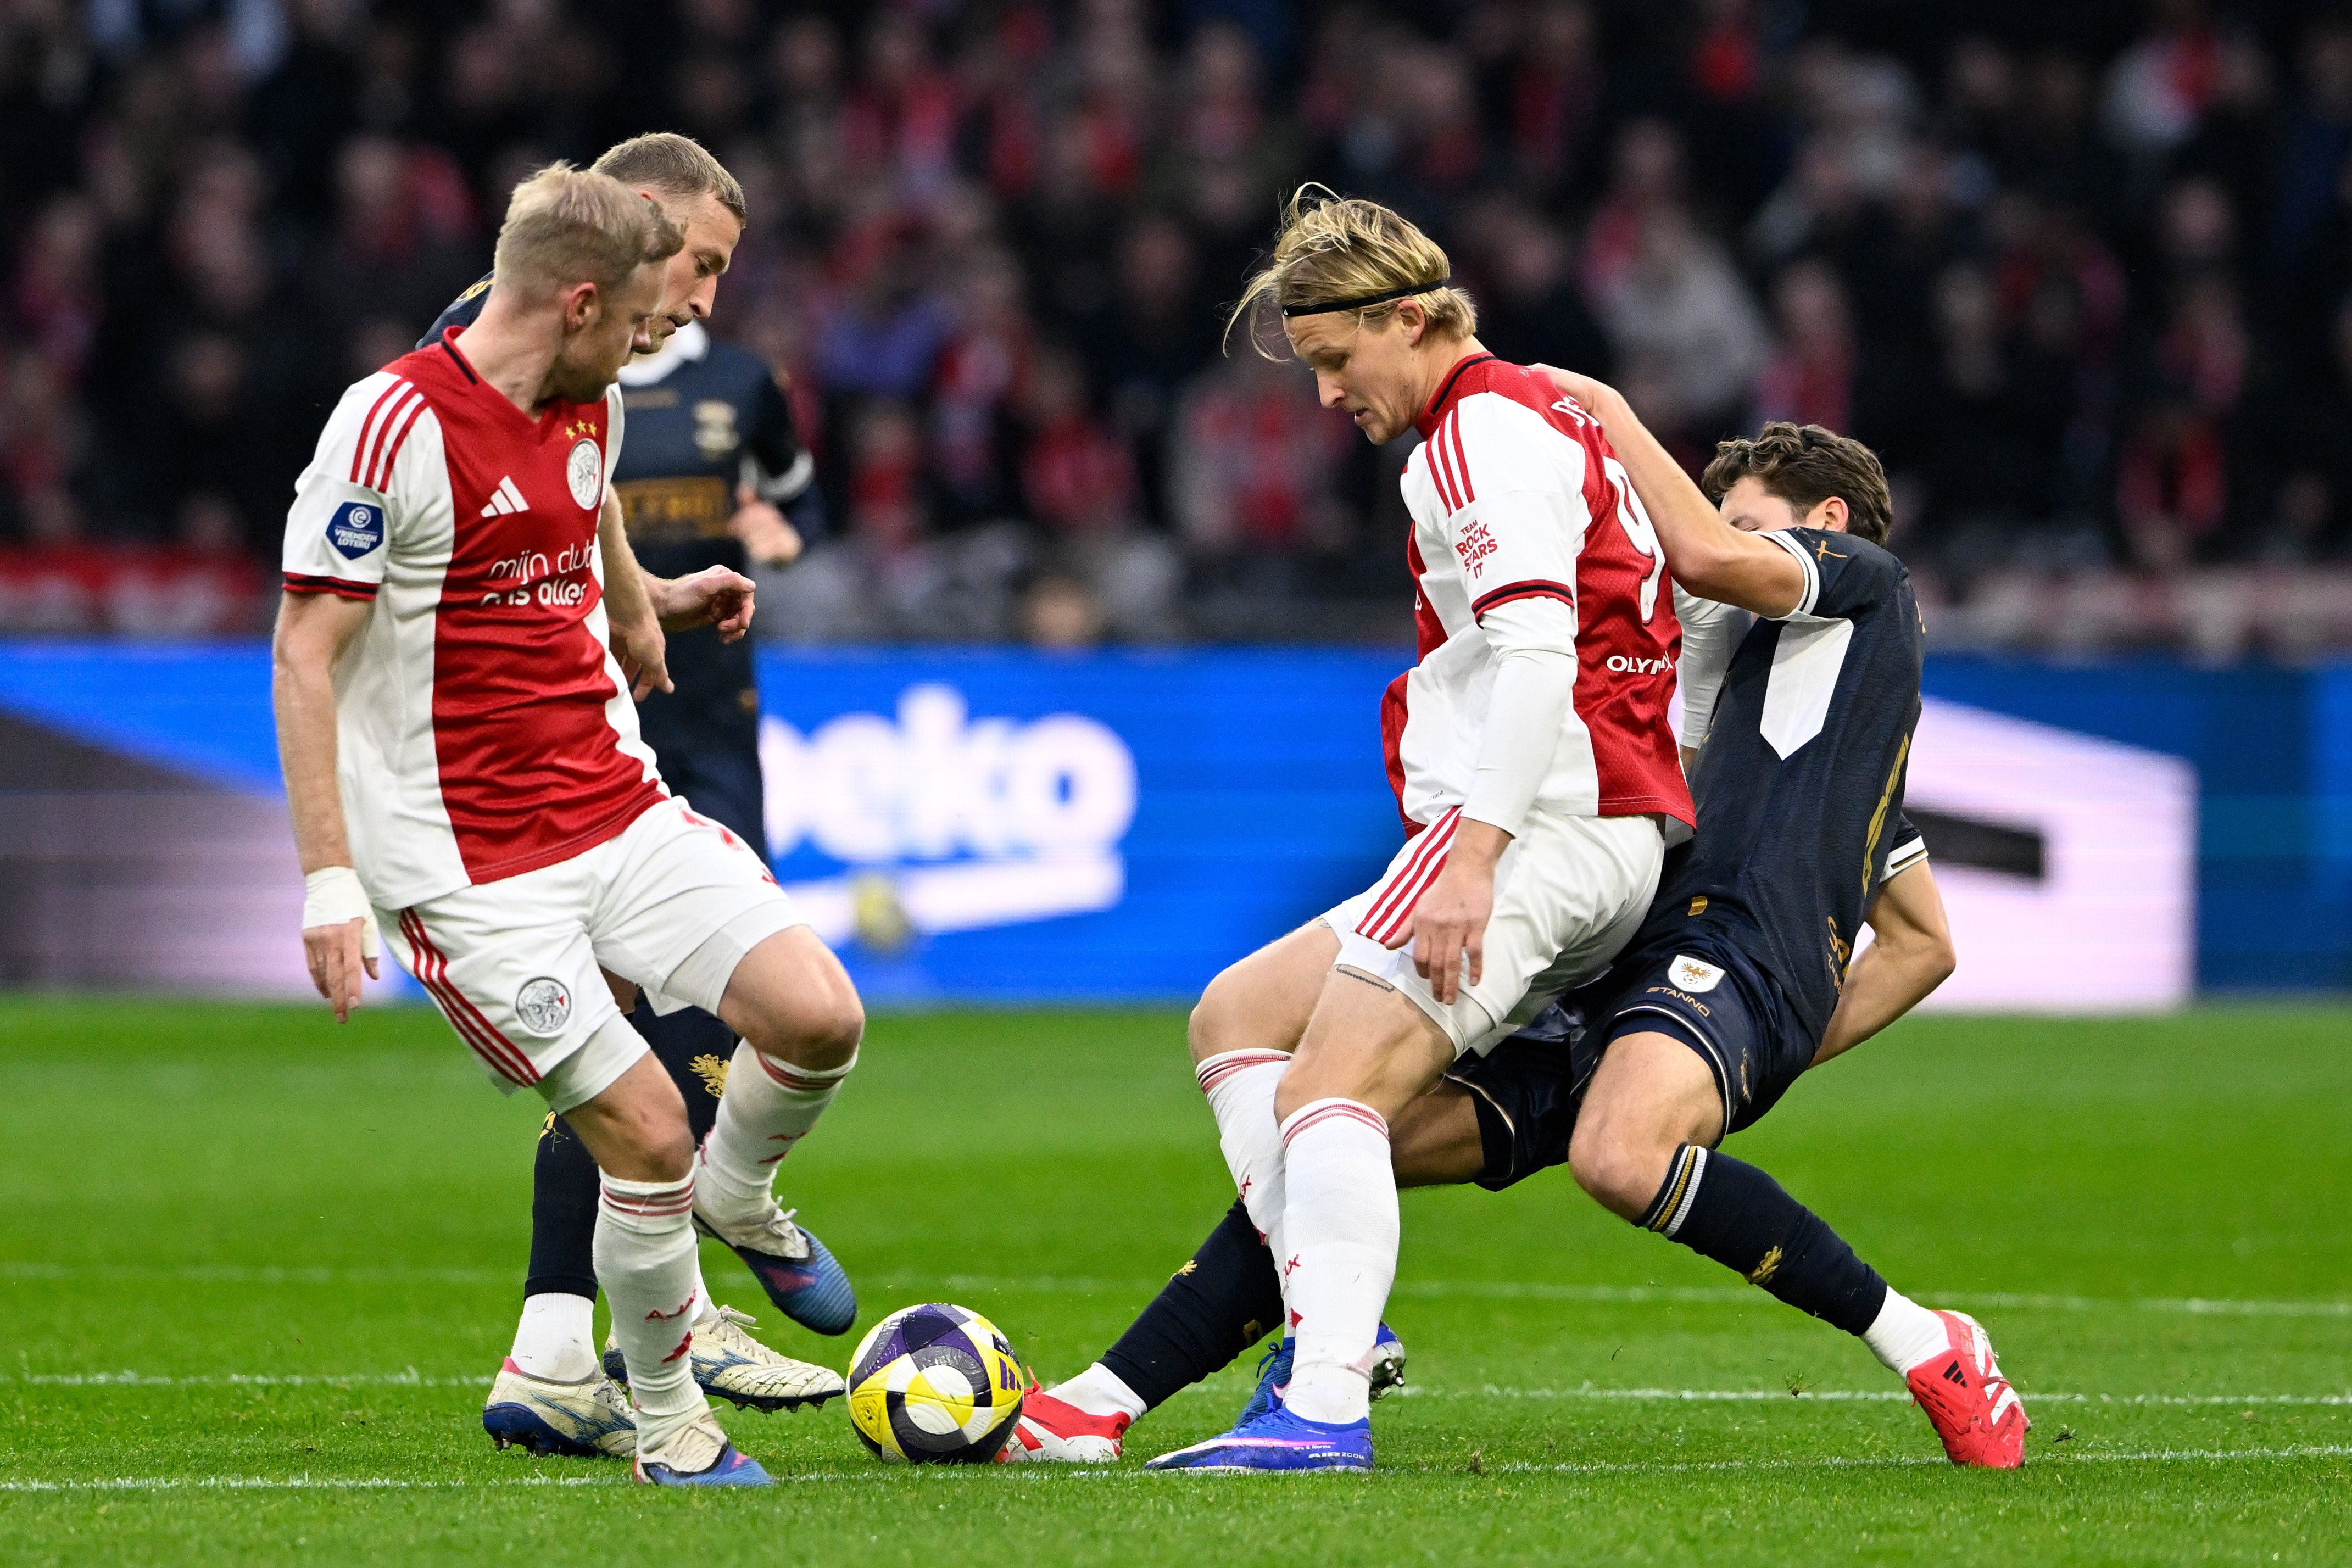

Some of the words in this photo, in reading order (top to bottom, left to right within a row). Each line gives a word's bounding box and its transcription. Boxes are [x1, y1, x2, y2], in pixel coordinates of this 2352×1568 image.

[1454, 523, 1491, 556] ROCK
[1460, 519, 1478, 535] TEAM
[1603, 455, 1666, 626] 9
[488, 549, 549, 585] mijn
[1473, 561, 1483, 579] IT
[538, 578, 587, 605] alles
[1342, 1452, 1364, 1460] ZOOM
